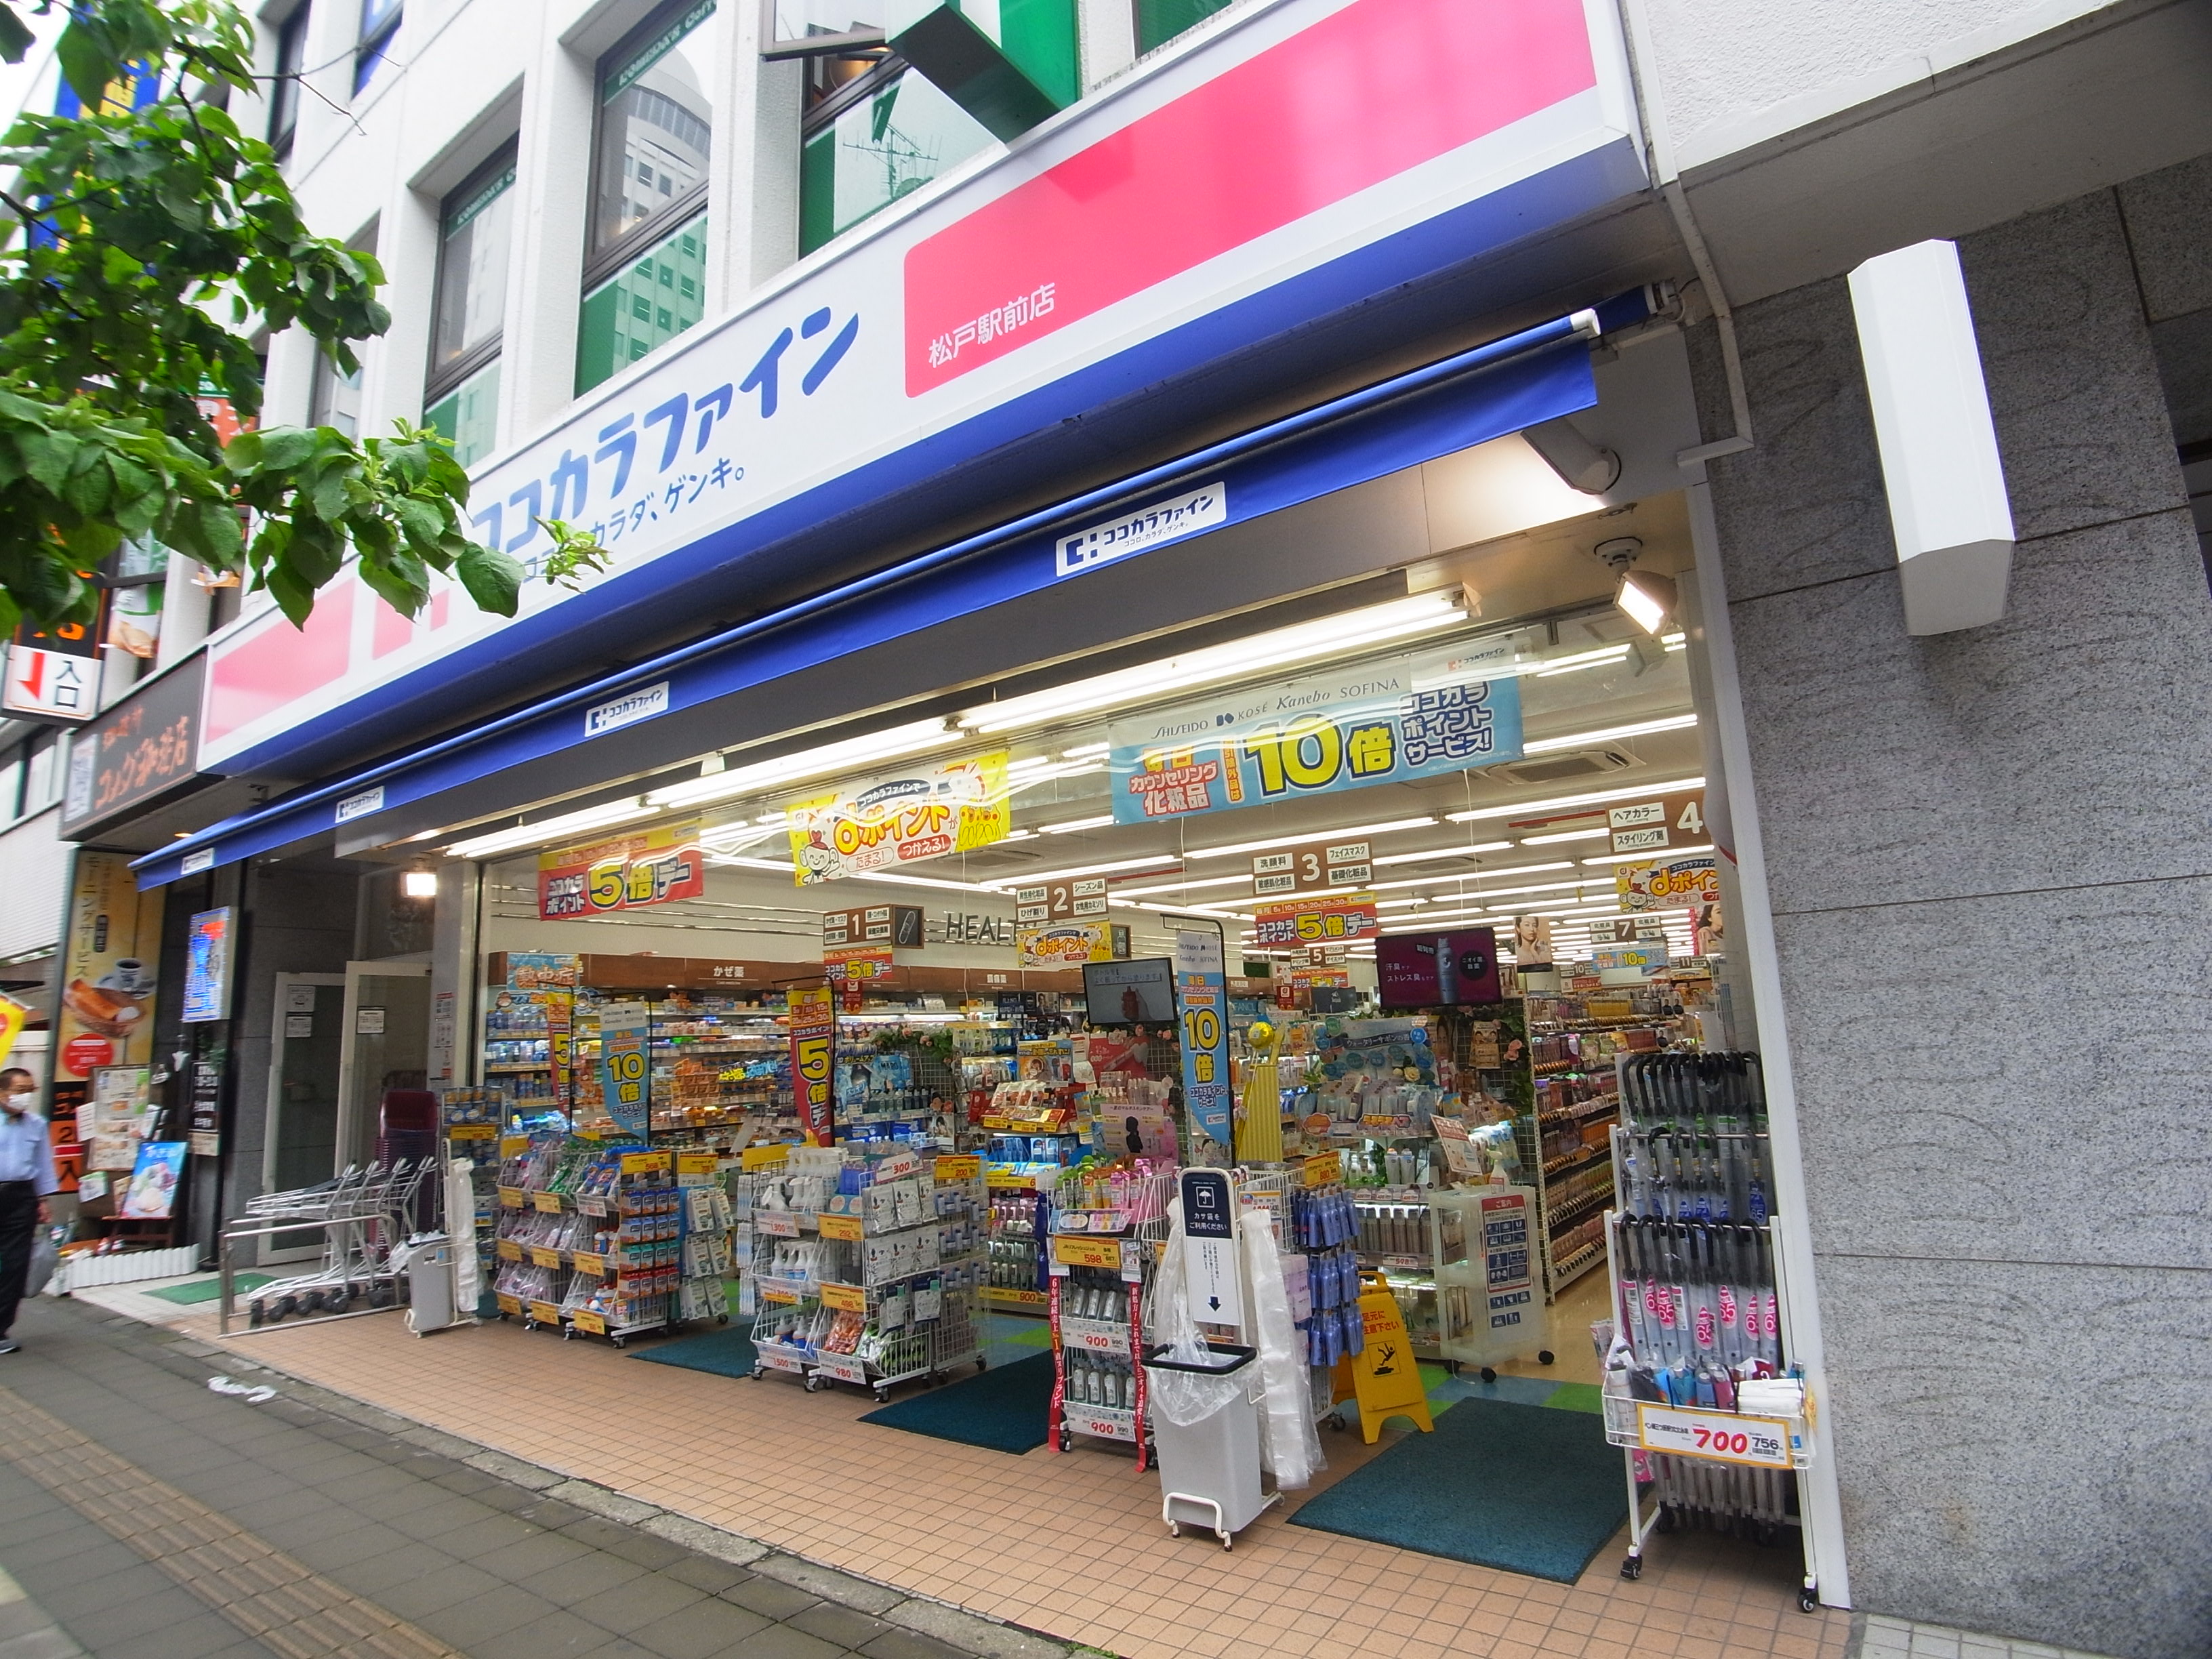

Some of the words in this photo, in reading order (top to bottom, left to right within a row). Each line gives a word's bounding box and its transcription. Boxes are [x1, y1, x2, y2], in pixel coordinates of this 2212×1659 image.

[928, 283, 1056, 368] 松戸駅前店
[471, 306, 859, 553] ココカラファイン
[1104, 495, 1214, 546] ココカラファイン
[54, 660, 82, 708] 入口
[609, 690, 663, 718] ココカラファイン
[1401, 681, 1488, 714] ココカラ
[1151, 720, 1208, 739] SHISEIDO
[1238, 702, 1268, 720] KOSÉ
[1276, 689, 1330, 710] Kanebo
[1340, 678, 1399, 699] SOFINA
[1404, 708, 1490, 738] ポイント
[1246, 713, 1394, 796] 10倍
[1131, 762, 1217, 792] カウンセリング
[1145, 783, 1209, 815] 化粧品
[1613, 807, 1660, 820] ヘアカラー
[1677, 801, 1704, 834] 4
[1617, 830, 1664, 846] スタイリング剤
[1330, 846, 1366, 858] フェイスマスク
[1260, 856, 1286, 868] 洗顔料
[1301, 853, 1321, 882] 3
[1331, 867, 1368, 880] 基礎化粧品
[548, 874, 584, 897] ココカラ
[1074, 881, 1103, 892] シーズン品
[1258, 876, 1292, 890] 敏感肌化粧品
[1019, 889, 1044, 900] 男性用化粧品
[1054, 887, 1069, 912] 2
[546, 897, 586, 915] ポイント
[1021, 907, 1044, 918] ひげ剃り
[1076, 900, 1104, 911] 女性用カミソリ
[852, 914, 859, 936] 1
[1258, 919, 1294, 933] ココカラ
[1296, 913, 1376, 941] 5倍デー
[1618, 921, 1631, 937] 7
[1259, 931, 1295, 944] ポイント
[1036, 936, 1088, 956] dポイント
[1313, 949, 1322, 962] 5
[1680, 958, 1690, 966] 11
[713, 966, 745, 978] かぜ薬
[825, 964, 846, 972] ココカラ
[846, 958, 892, 981] 5倍デー
[1574, 965, 1584, 974] 10
[893, 1161, 910, 1174] 300
[956, 1168, 967, 1176] 200
[1189, 1222, 1227, 1230] ご利用ください
[1084, 1254, 1102, 1264] 598
[1019, 1292, 1036, 1303] 900
[1658, 1305, 1675, 1323] 65
[1086, 1335, 1109, 1347] 900
[836, 1367, 851, 1378] 980
[1091, 1422, 1114, 1434] 900
[1692, 1428, 1748, 1454] 700
[1751, 1437, 1780, 1450] 756
